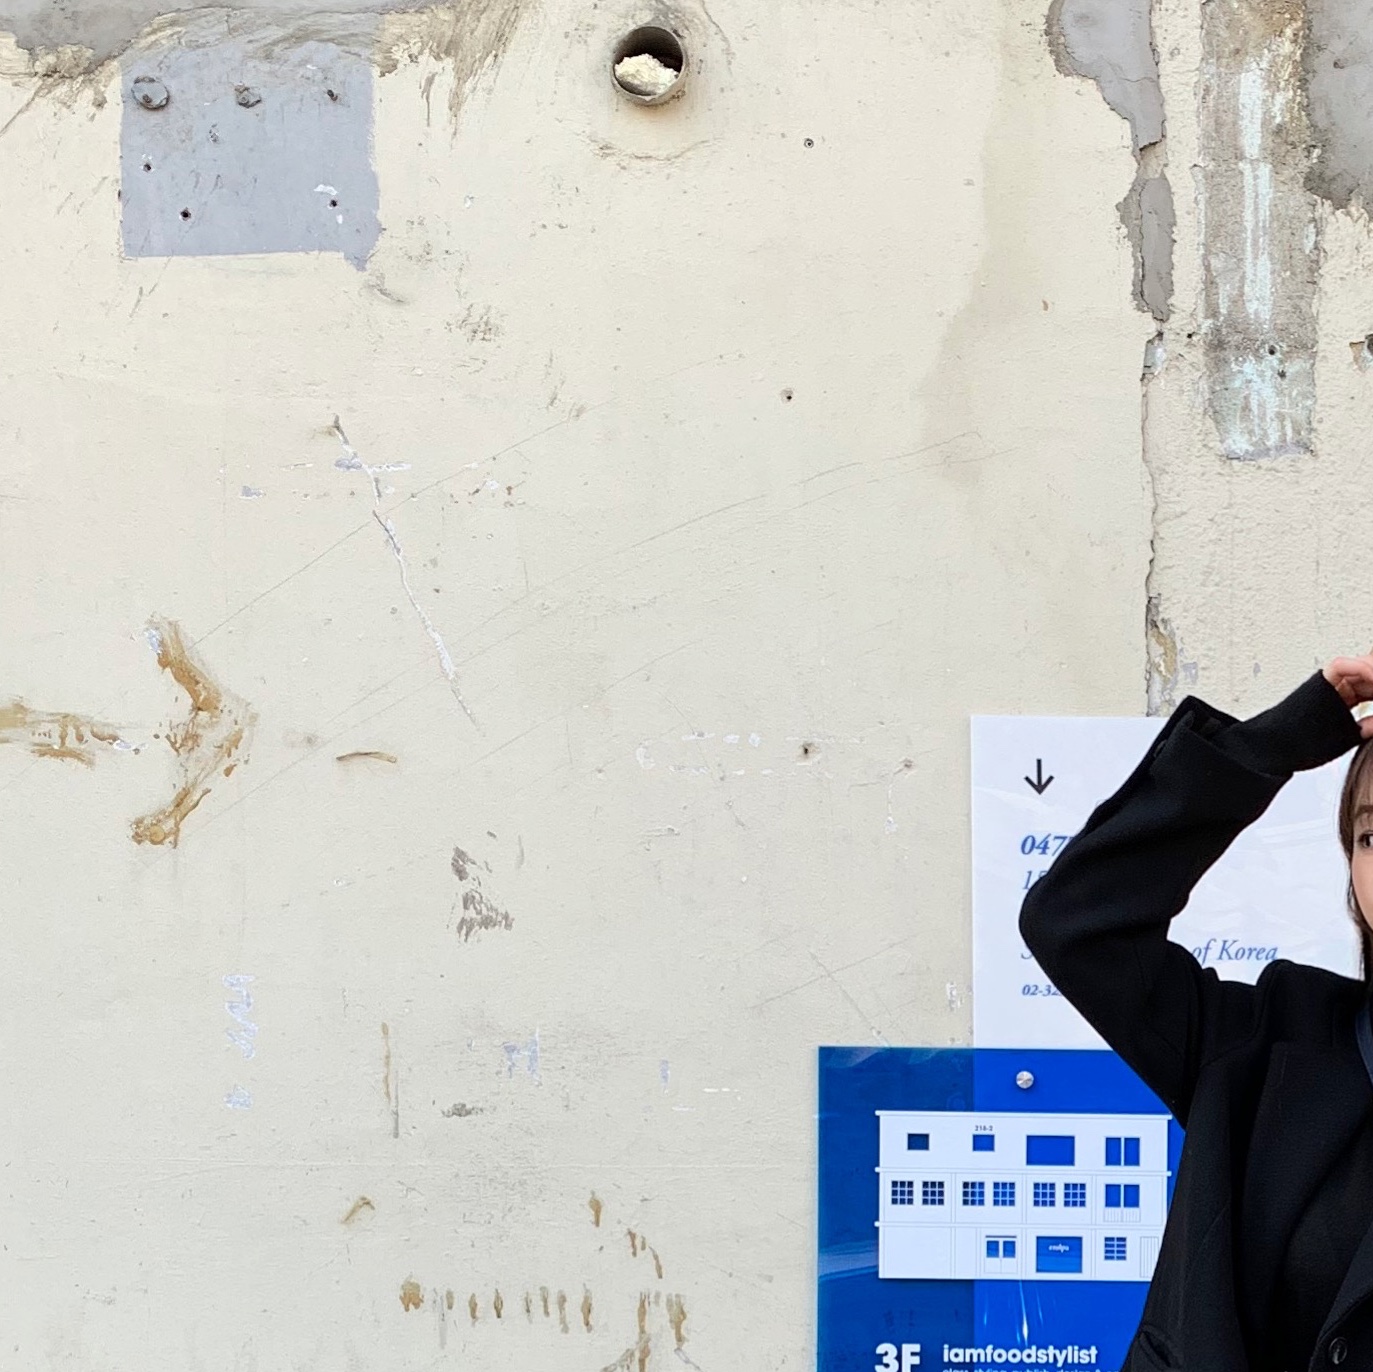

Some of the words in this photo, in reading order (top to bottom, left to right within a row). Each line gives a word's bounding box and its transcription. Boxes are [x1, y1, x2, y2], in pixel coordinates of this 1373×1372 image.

[1020, 833, 1075, 856] 047
[1192, 938, 1217, 965] of
[1217, 939, 1278, 961] Korea
[943, 1344, 1098, 1368] iamfoodstylist
